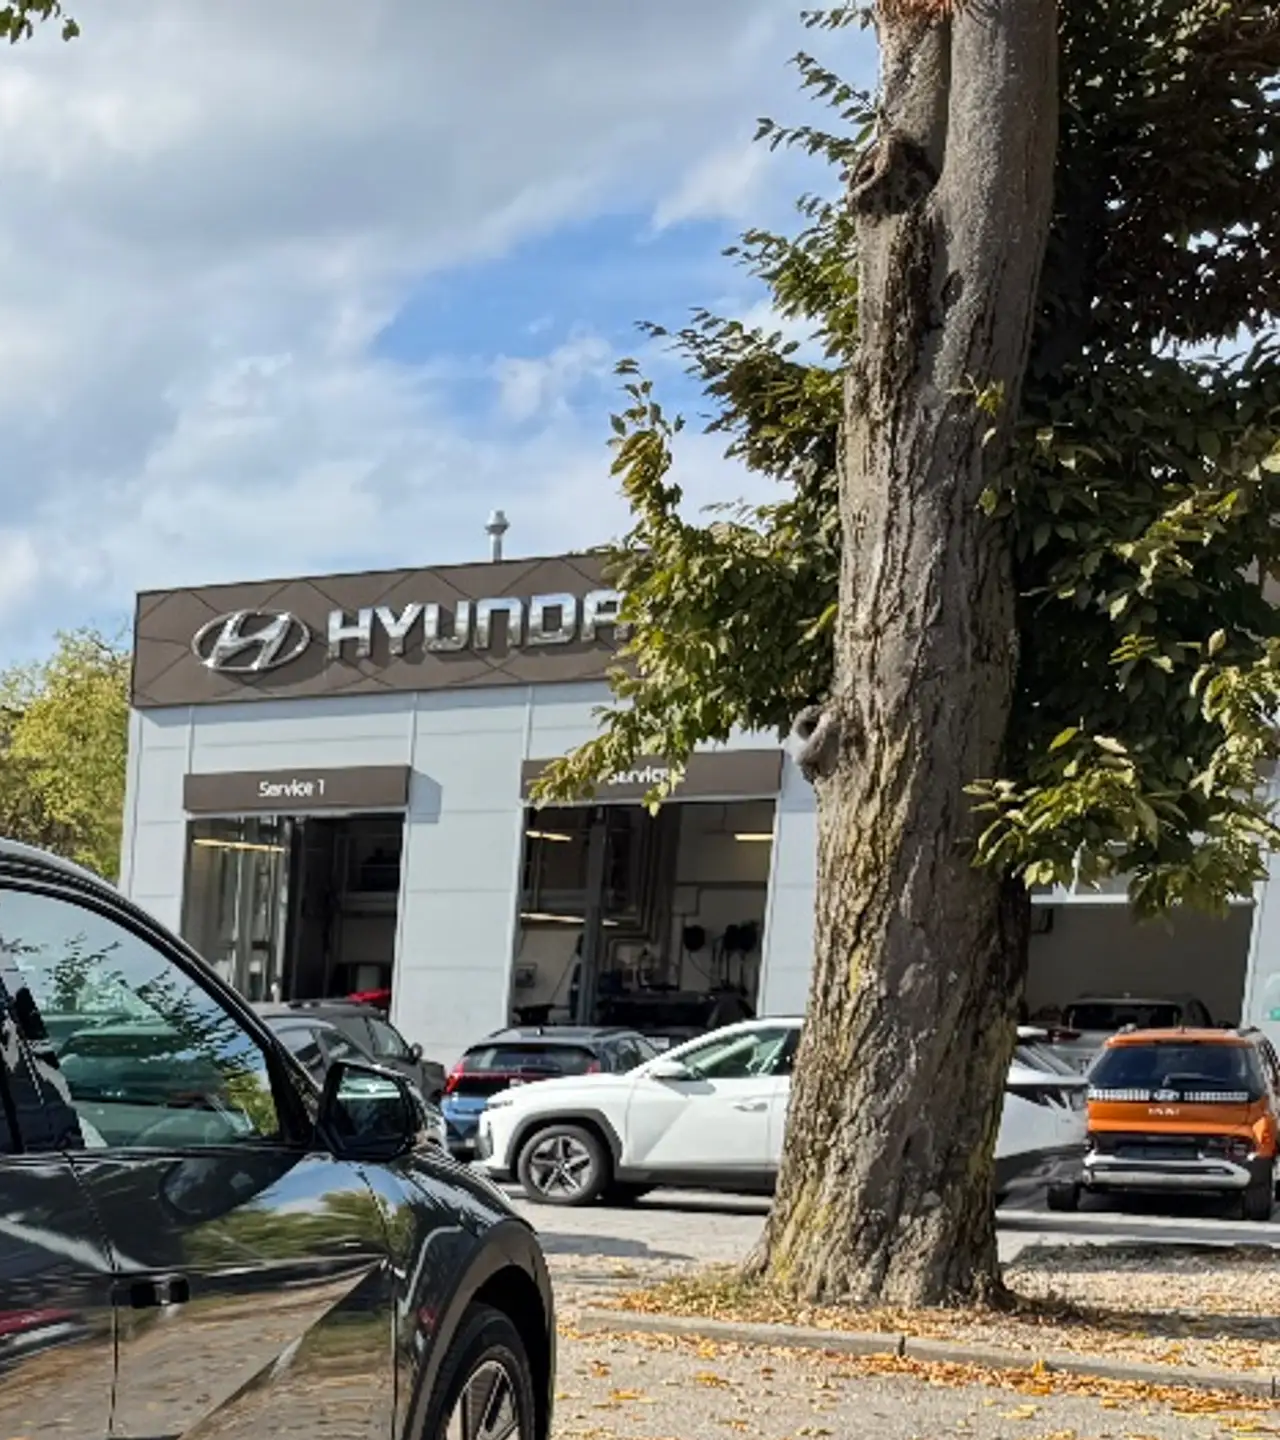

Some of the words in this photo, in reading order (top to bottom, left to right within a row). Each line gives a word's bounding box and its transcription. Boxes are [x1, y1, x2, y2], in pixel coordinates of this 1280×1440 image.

[328, 589, 633, 660] HYUNDA
[257, 779, 313, 797] Service
[317, 778, 325, 796] 1
